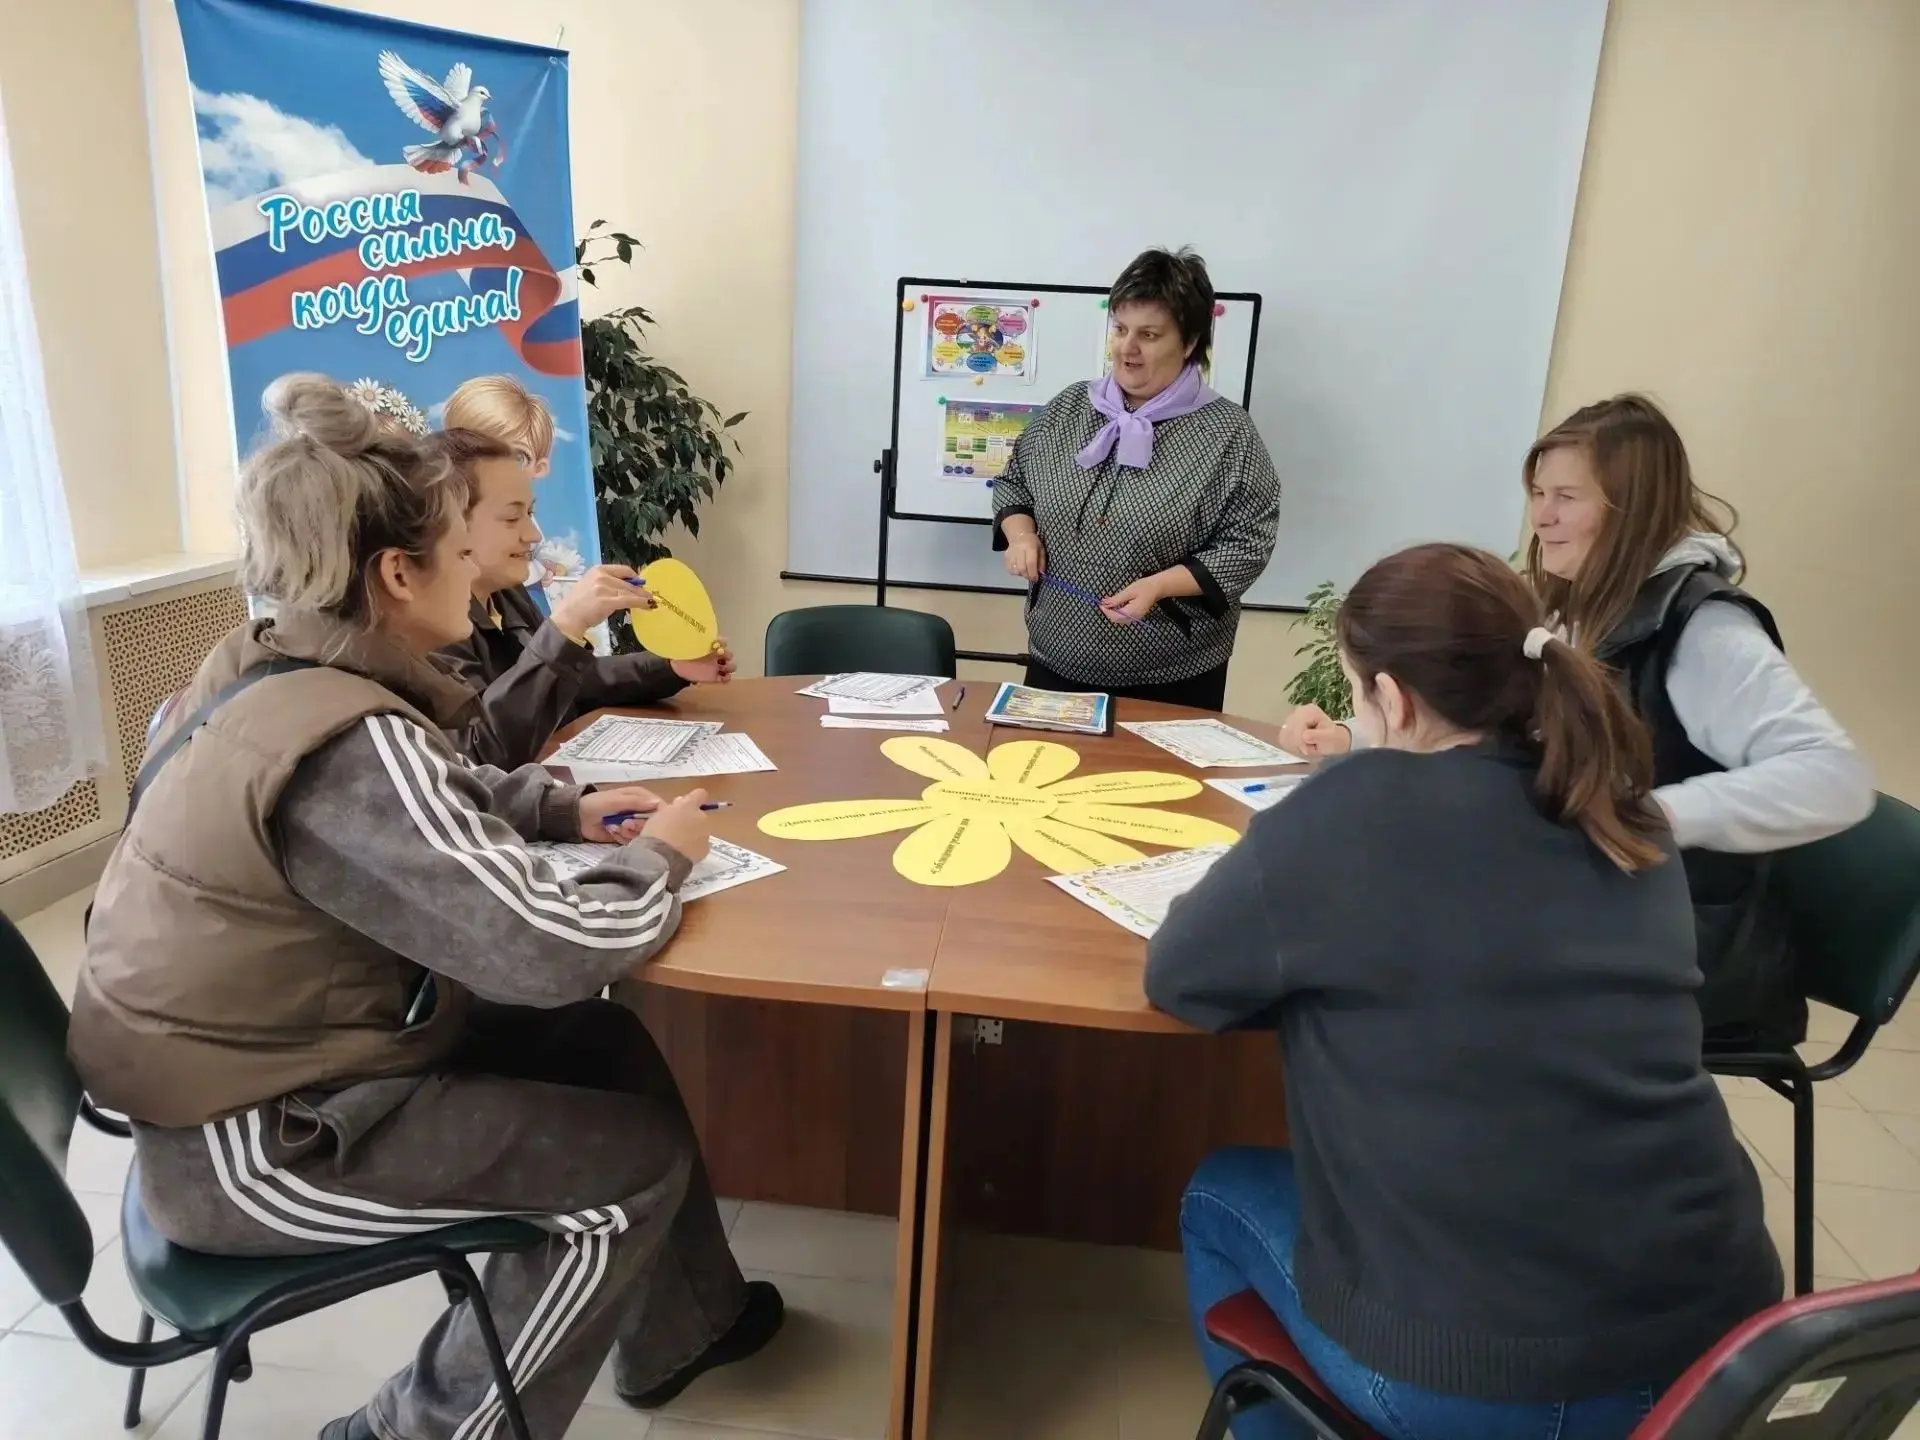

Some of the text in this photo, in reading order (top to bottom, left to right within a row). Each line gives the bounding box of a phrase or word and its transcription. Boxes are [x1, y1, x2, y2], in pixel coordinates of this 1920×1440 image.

[259, 189, 421, 251] Россия
[360, 213, 516, 270] сильна,
[293, 275, 409, 334] когда
[386, 266, 523, 362] едина!
